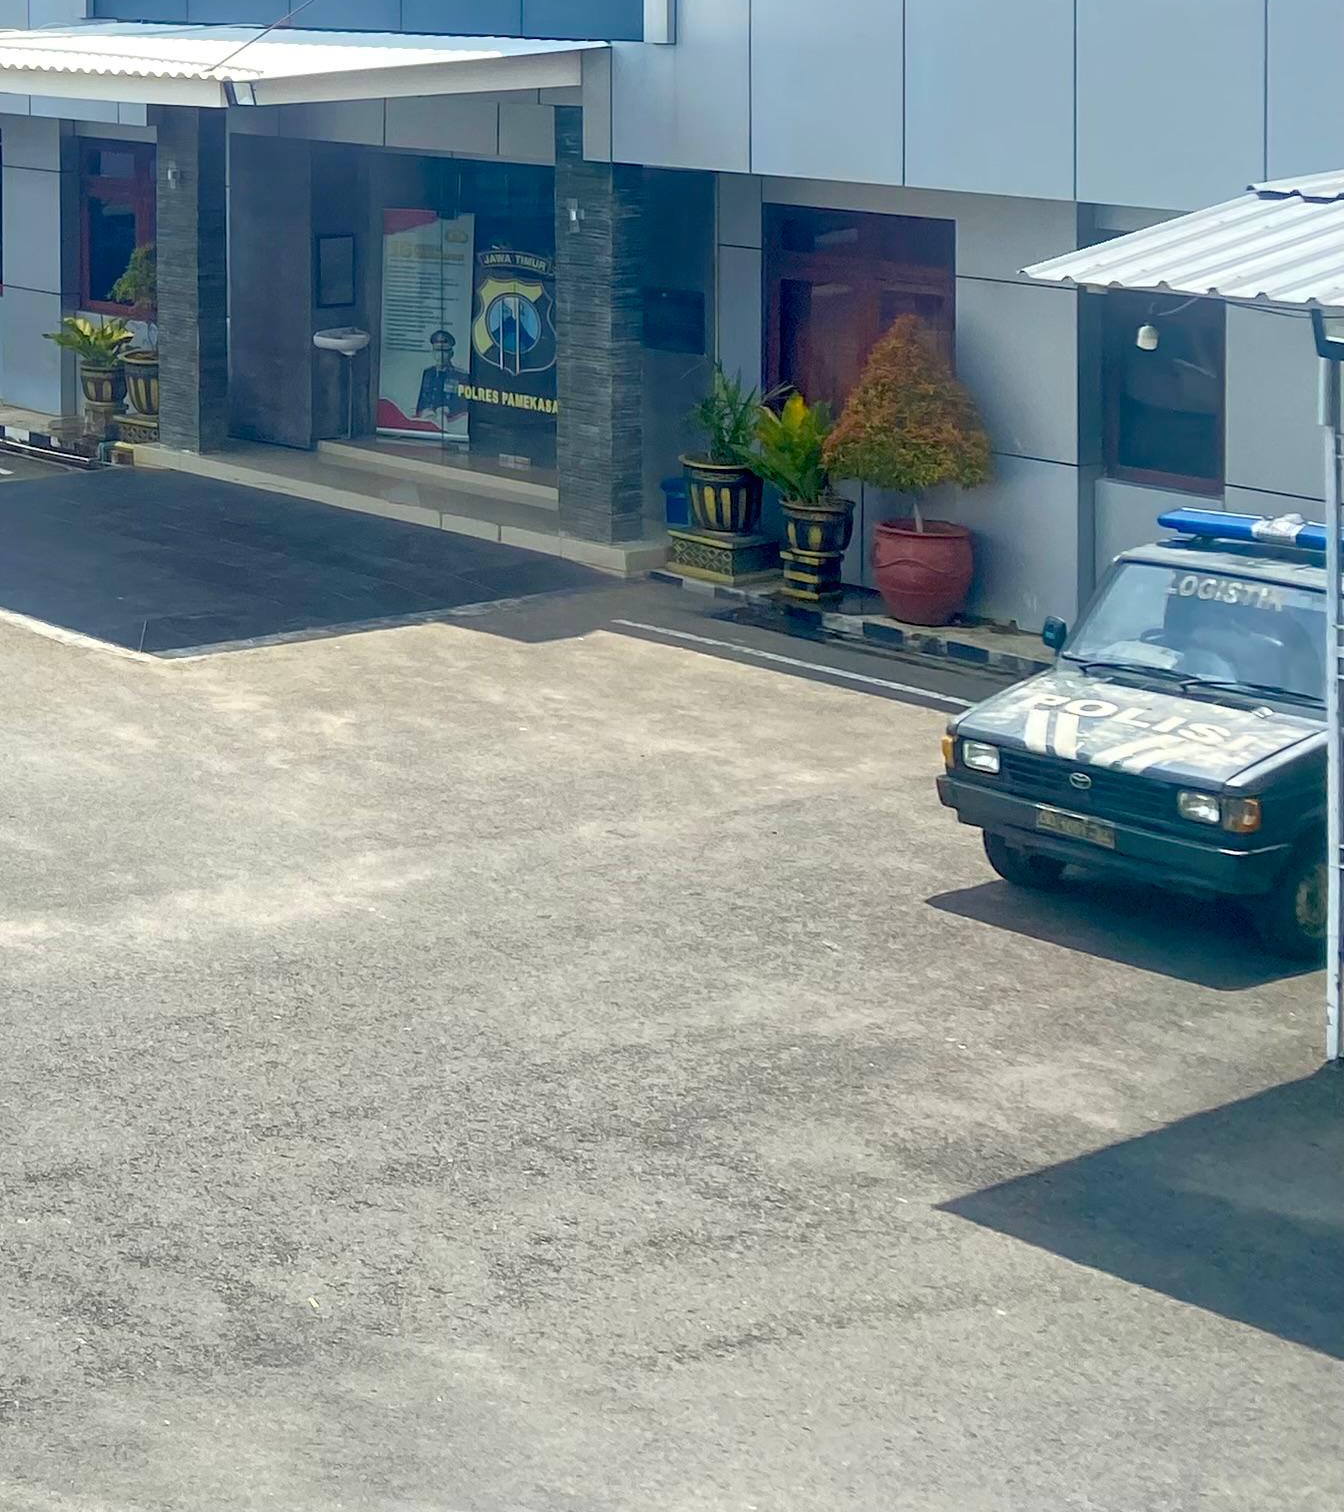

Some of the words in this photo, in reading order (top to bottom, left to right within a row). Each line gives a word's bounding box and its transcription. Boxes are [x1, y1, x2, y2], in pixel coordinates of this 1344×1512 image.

[484, 253, 511, 265] JAWA
[515, 255, 546, 272] TIMUR
[457, 384, 500, 405] POLRES
[501, 391, 560, 414] PAMEKASA
